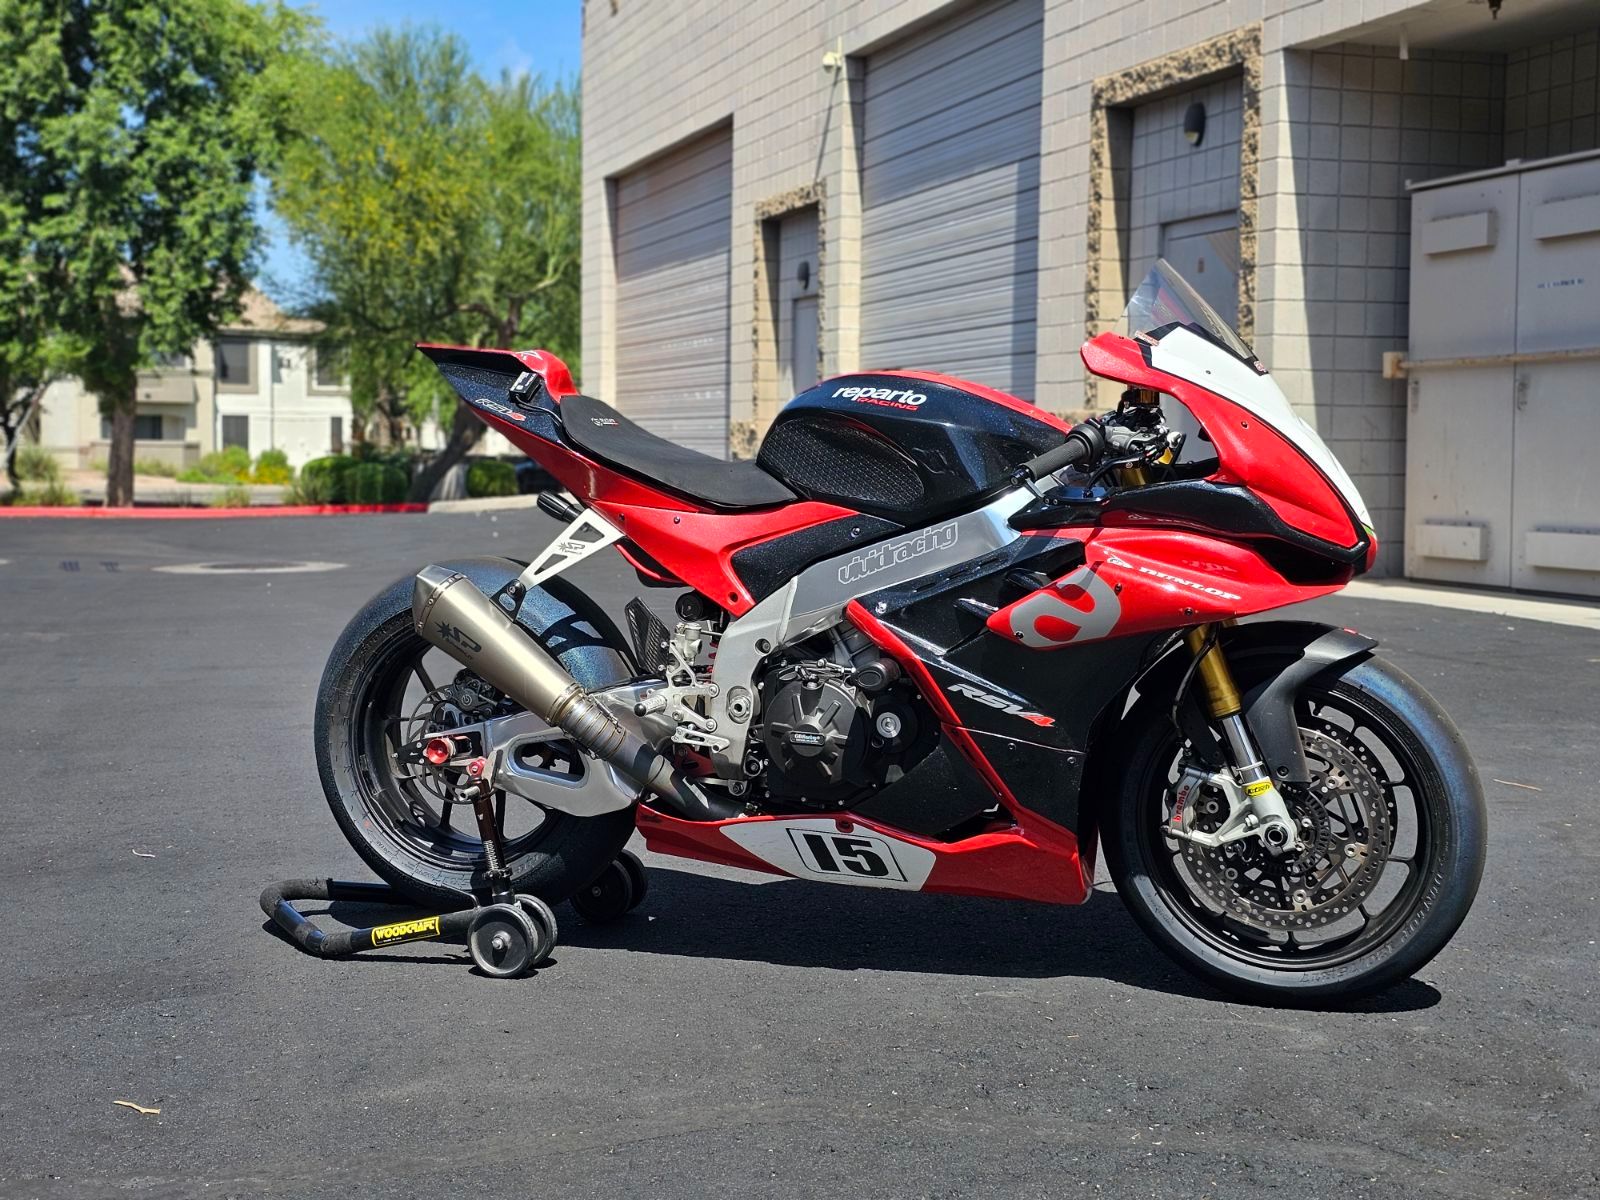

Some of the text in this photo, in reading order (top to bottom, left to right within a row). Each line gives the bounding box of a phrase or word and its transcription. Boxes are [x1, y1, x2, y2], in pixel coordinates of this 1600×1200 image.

[832, 386, 927, 405] reparto
[857, 397, 920, 411] RACING
[1139, 566, 1242, 600] DUNLOP
[1172, 785, 1190, 822] brembo
[802, 833, 889, 876] 15
